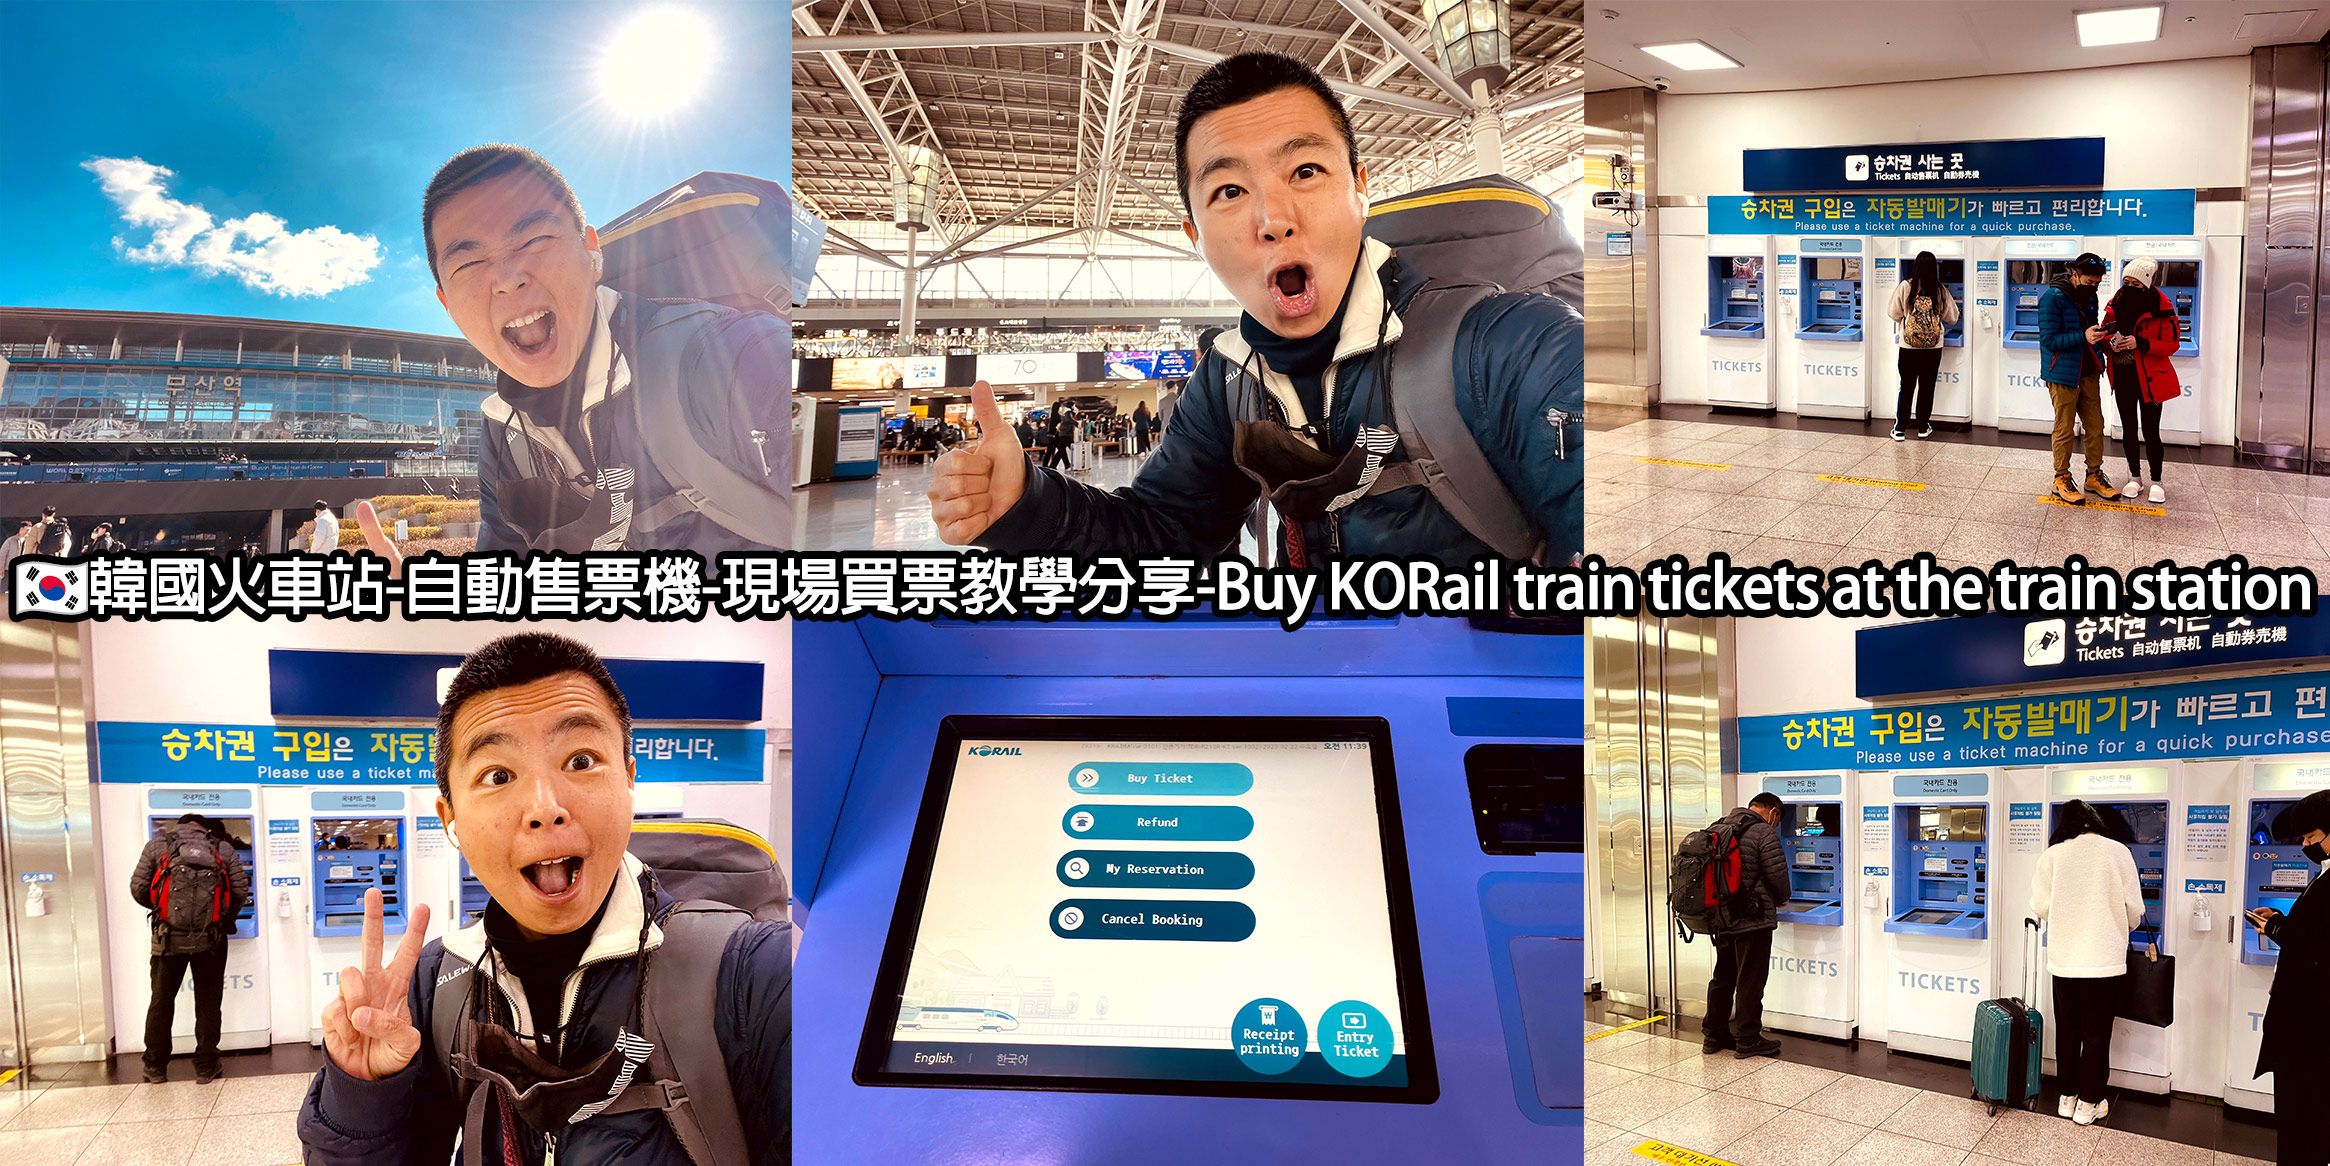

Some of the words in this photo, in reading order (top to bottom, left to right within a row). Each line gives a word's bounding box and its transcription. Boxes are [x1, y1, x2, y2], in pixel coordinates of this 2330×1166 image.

[1874, 155, 1911, 171] 승차권
[1918, 154, 1944, 170] 사는
[1950, 153, 1963, 170] 곳
[1875, 172, 1901, 180] Tickets
[1741, 199, 1794, 220] 승차권
[1804, 199, 1856, 219] 구입은
[1867, 197, 1984, 219] 자동발매기가
[1992, 200, 2041, 218] 빠르고
[2052, 198, 2147, 218] 편리합니다.
[1795, 222, 1827, 231] Please
[1832, 224, 1849, 232] use
[1854, 224, 1860, 232] a
[1865, 222, 1895, 232] ticket
[1900, 222, 1944, 232] machine
[1949, 222, 1965, 232] for
[1970, 224, 1977, 232] a
[1982, 222, 2012, 233] quick
[2018, 222, 2076, 233] purchase.
[1712, 361, 1762, 373] TICKETS
[1804, 364, 1859, 377] TICKETS
[165, 375, 242, 397] 부산역
[506, 431, 519, 445] SAL
[2076, 646, 2124, 662] Tickets
[2132, 635, 2202, 658] 自动售票机
[2211, 626, 2288, 649] 自動券売機
[1782, 716, 1855, 750] 승차권
[1869, 711, 1946, 745] 구입은
[1963, 695, 2161, 741] 자동발매기가
[2176, 690, 2273, 726] 빠르고
[2295, 686, 2327, 719] 편
[162, 728, 256, 761] 승차권
[272, 731, 354, 762] 구입은
[630, 737, 719, 761] 리합니다.
[968, 745, 1023, 757] KORAIL
[1323, 742, 1341, 751] 오전
[1343, 743, 1368, 751] 11:39
[1857, 750, 1902, 764] Please
[1909, 751, 1935, 763] use
[1943, 751, 1952, 761] a
[1960, 745, 2007, 760] ticket
[2015, 740, 2088, 758] machine
[2098, 739, 2126, 754] for
[2135, 741, 2146, 752] a
[2157, 733, 2214, 754] quick
[258, 766, 309, 779] Please
[317, 768, 345, 779] use
[352, 769, 361, 779] a
[368, 766, 412, 779] ticket
[1127, 774, 1148, 785] Buy
[1154, 773, 1193, 784] Ticket
[2088, 775, 2115, 784] 국내카드
[1923, 779, 1945, 788] 국내카드
[1947, 779, 1958, 788] 전용
[1137, 817, 1179, 828] Refund
[1106, 863, 1121, 876] My
[1127, 864, 1205, 875] Reservation
[1101, 912, 1145, 925] Cancel
[1152, 914, 1204, 928] Booking
[1770, 956, 1838, 977] TICKETS
[1898, 971, 1981, 995] TICKETS
[1243, 1028, 1295, 1043] Receipt
[1337, 1031, 1374, 1045] Entry
[1240, 1043, 1300, 1058] printing
[1334, 1045, 1380, 1058] Ticket
[914, 1052, 954, 1065] English
[997, 1053, 1029, 1067] 한국어
